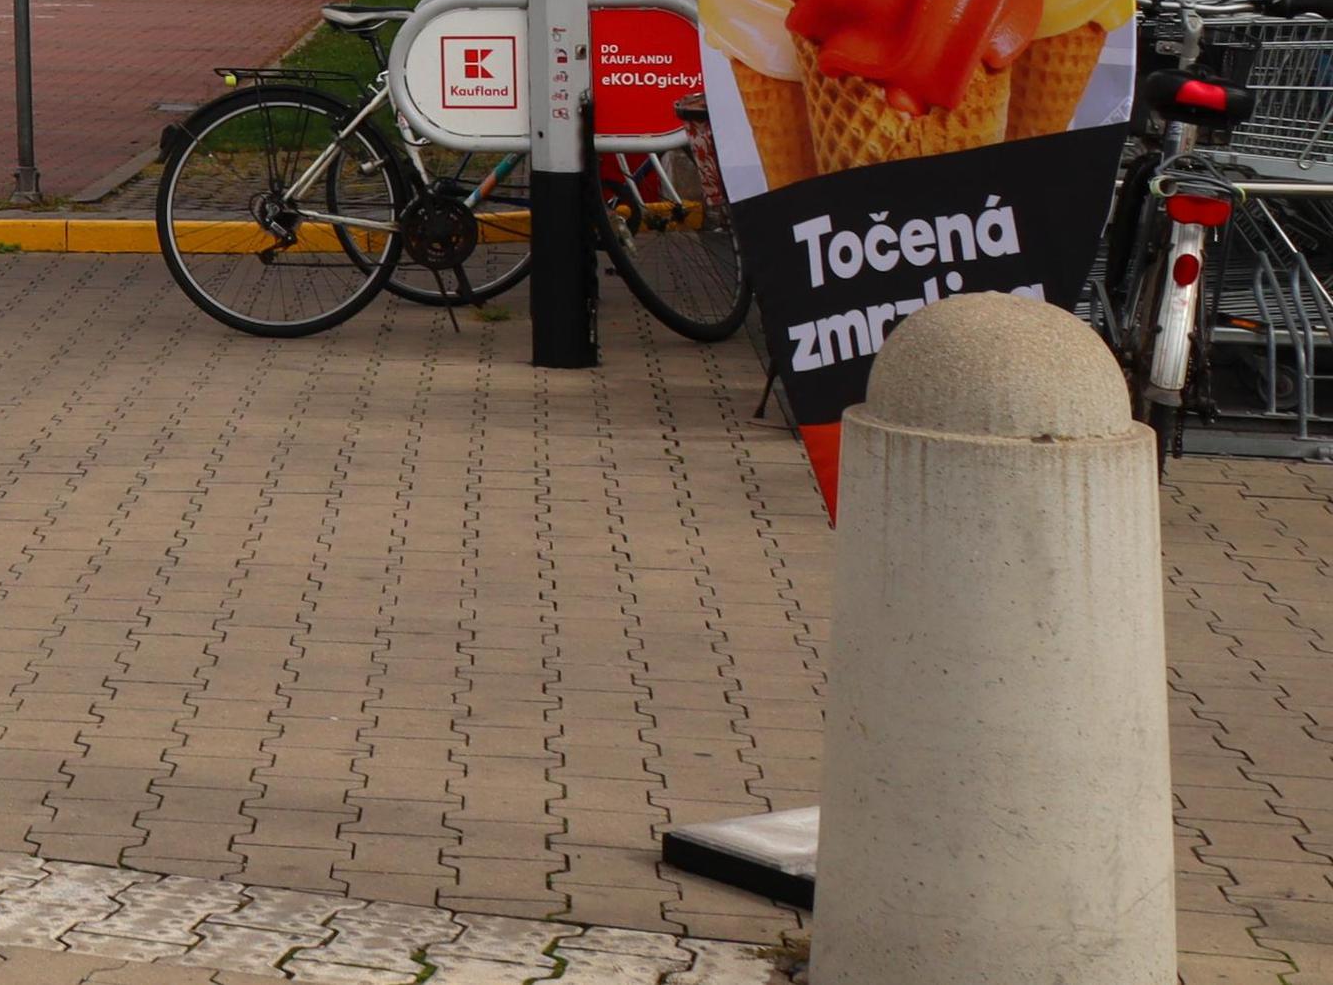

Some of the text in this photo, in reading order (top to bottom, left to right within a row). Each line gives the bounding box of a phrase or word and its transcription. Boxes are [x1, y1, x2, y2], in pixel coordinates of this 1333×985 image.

[600, 44, 619, 54] DO
[600, 55, 673, 65] KAUFLANDU
[601, 72, 703, 89] eKOLOgicky!
[450, 85, 509, 96] Kaufland
[792, 194, 1021, 288] Točená
